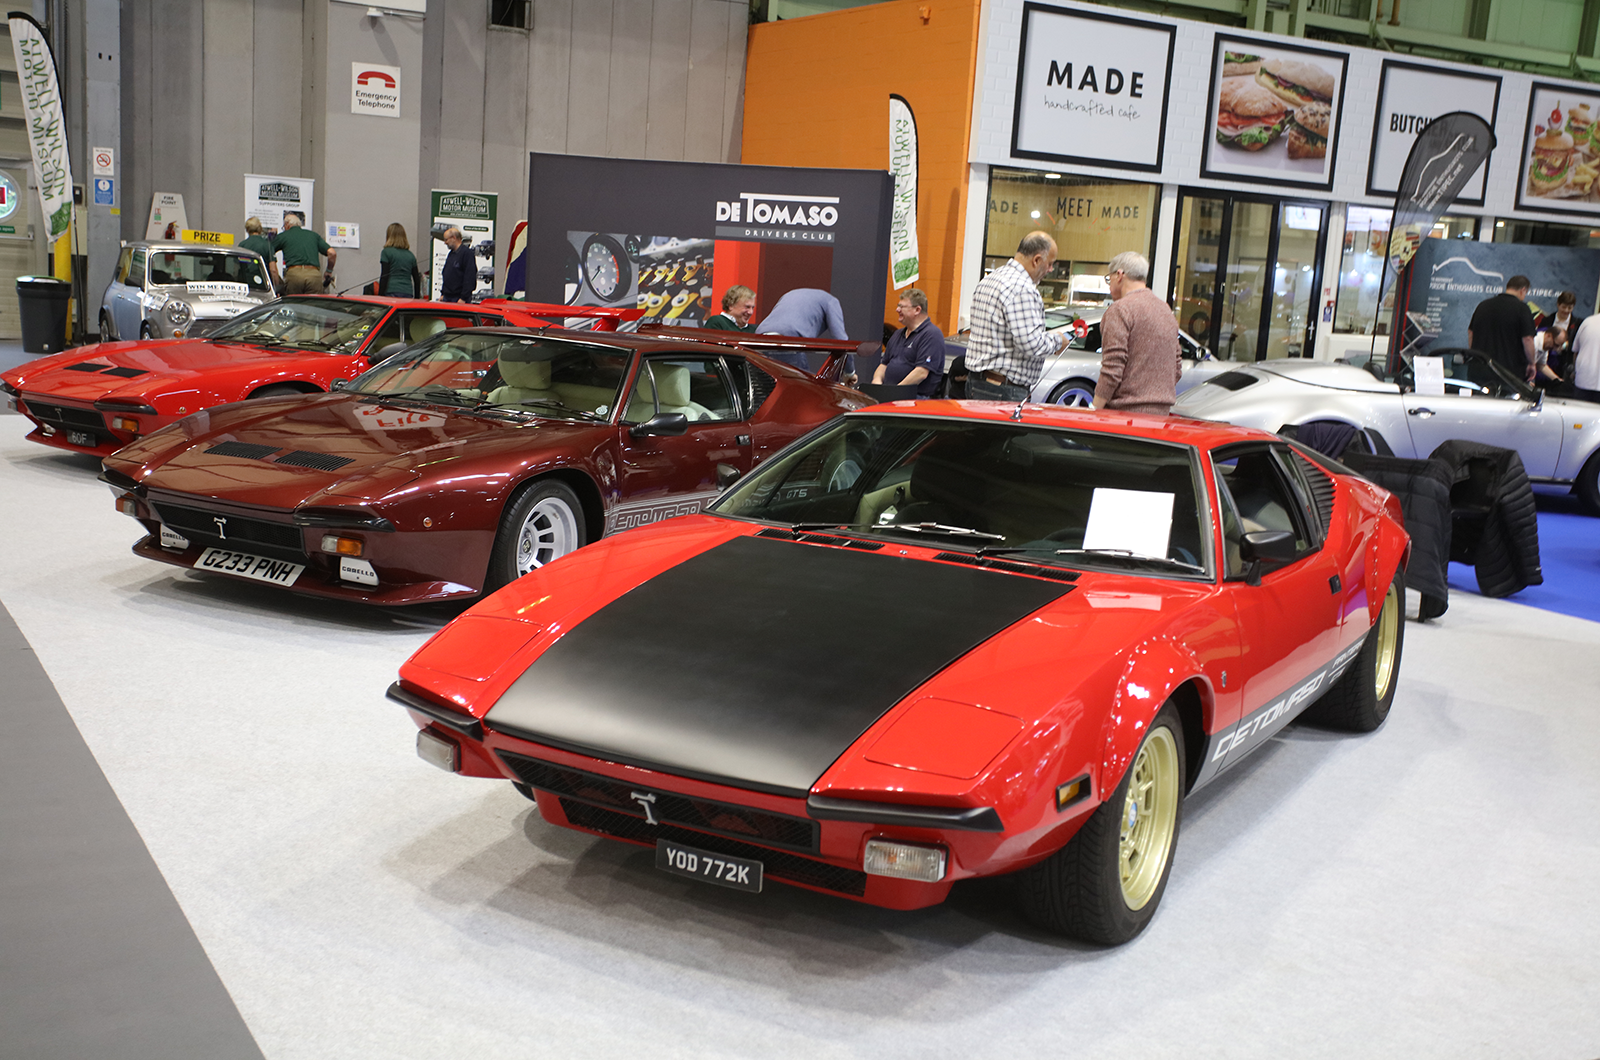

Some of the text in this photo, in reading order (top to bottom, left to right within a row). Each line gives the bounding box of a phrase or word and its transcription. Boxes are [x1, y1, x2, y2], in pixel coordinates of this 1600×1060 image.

[1046, 60, 1144, 99] MADE
[355, 90, 398, 102] Emergency
[358, 99, 396, 110] Telephone
[1044, 95, 1114, 117] handcrafted
[462, 205, 486, 213] MUSEUM
[716, 192, 840, 226] DE TOMASO
[989, 200, 1019, 214] ADE
[1056, 197, 1093, 220] MEET
[1102, 206, 1139, 219] MADE
[193, 231, 221, 243] PRIZE
[745, 229, 833, 241] DRIVERS CLUB
[203, 549, 297, 582] G233 PNH
[342, 565, 375, 578] CARELLO
[666, 847, 750, 885] YOD 772K
